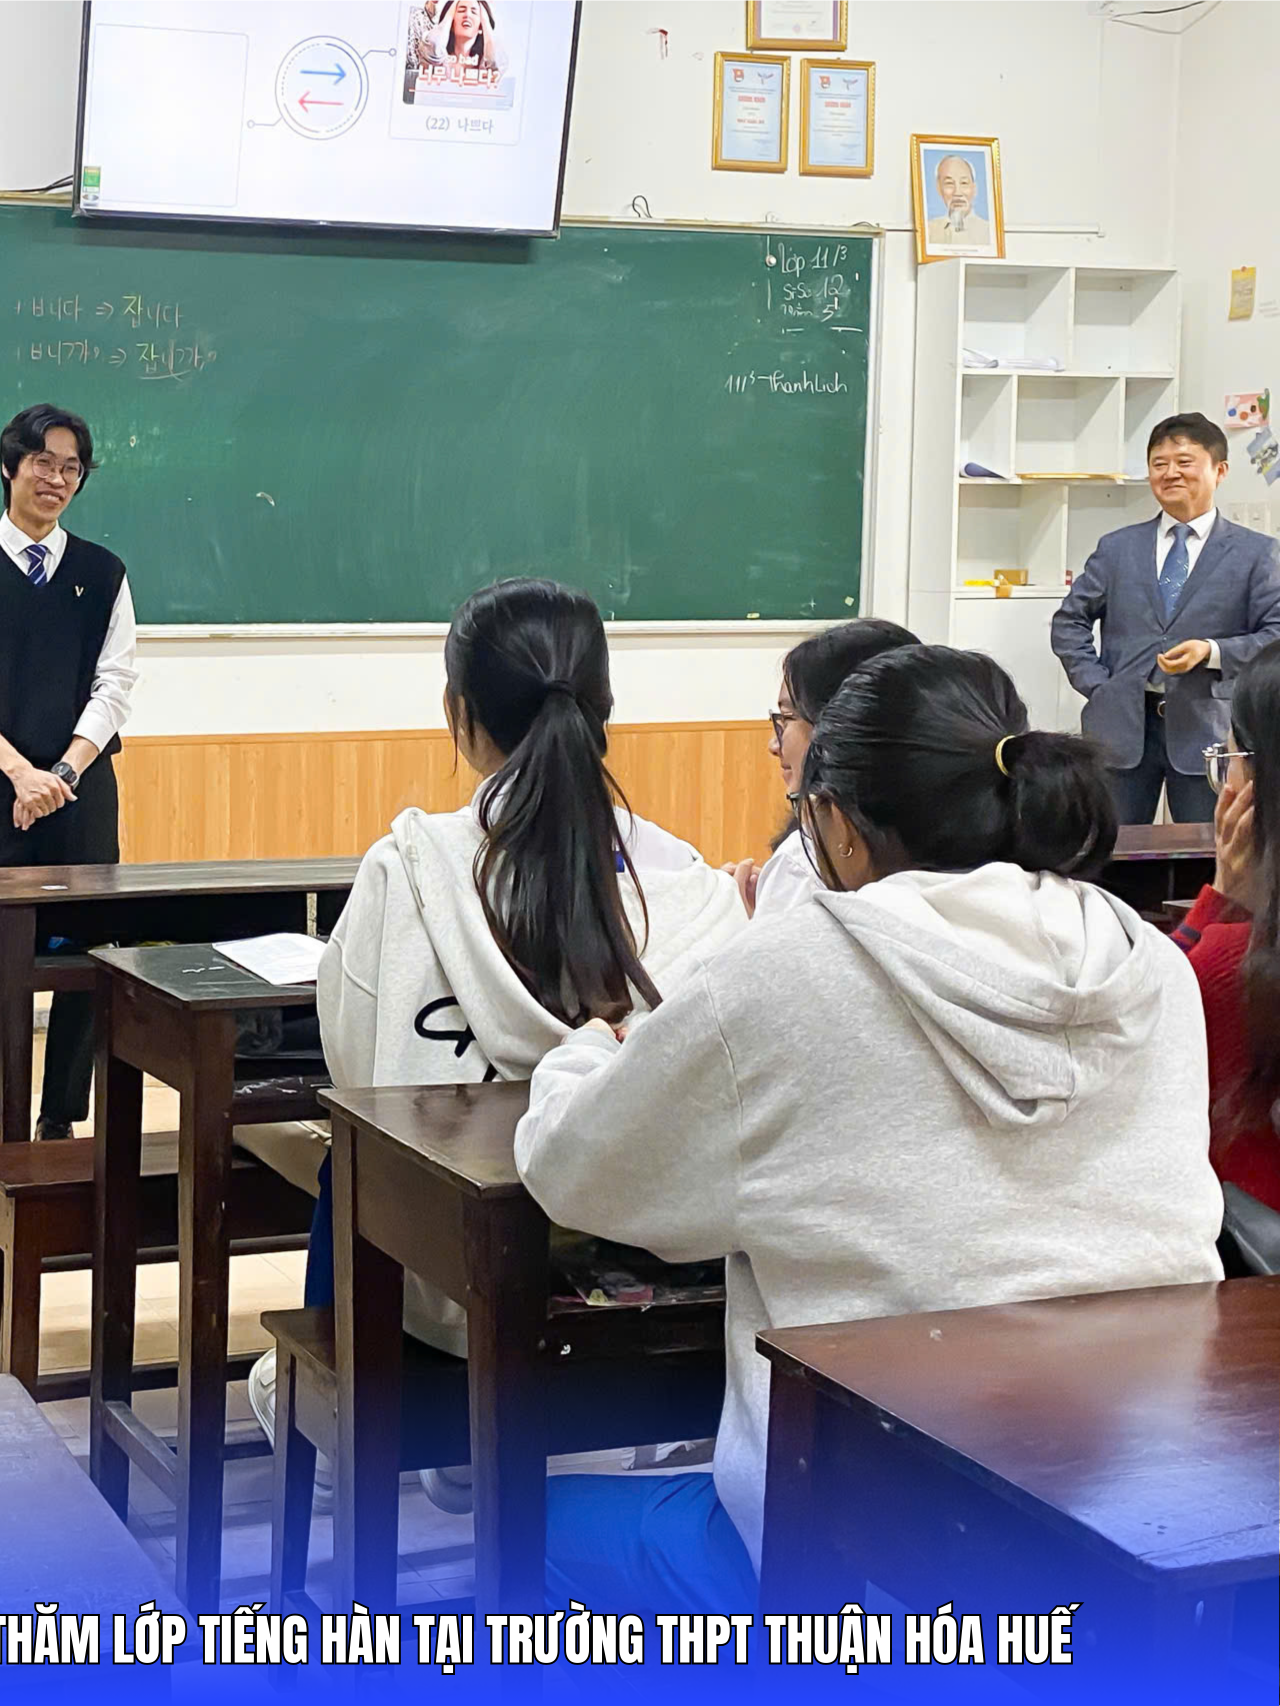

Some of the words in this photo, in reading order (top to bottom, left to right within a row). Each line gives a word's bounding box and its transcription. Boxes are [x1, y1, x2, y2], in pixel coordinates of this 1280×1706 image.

[458, 54, 480, 66] bad
[418, 64, 448, 86] 너무
[425, 115, 450, 132] (22)
[457, 117, 494, 134] 나쁘다
